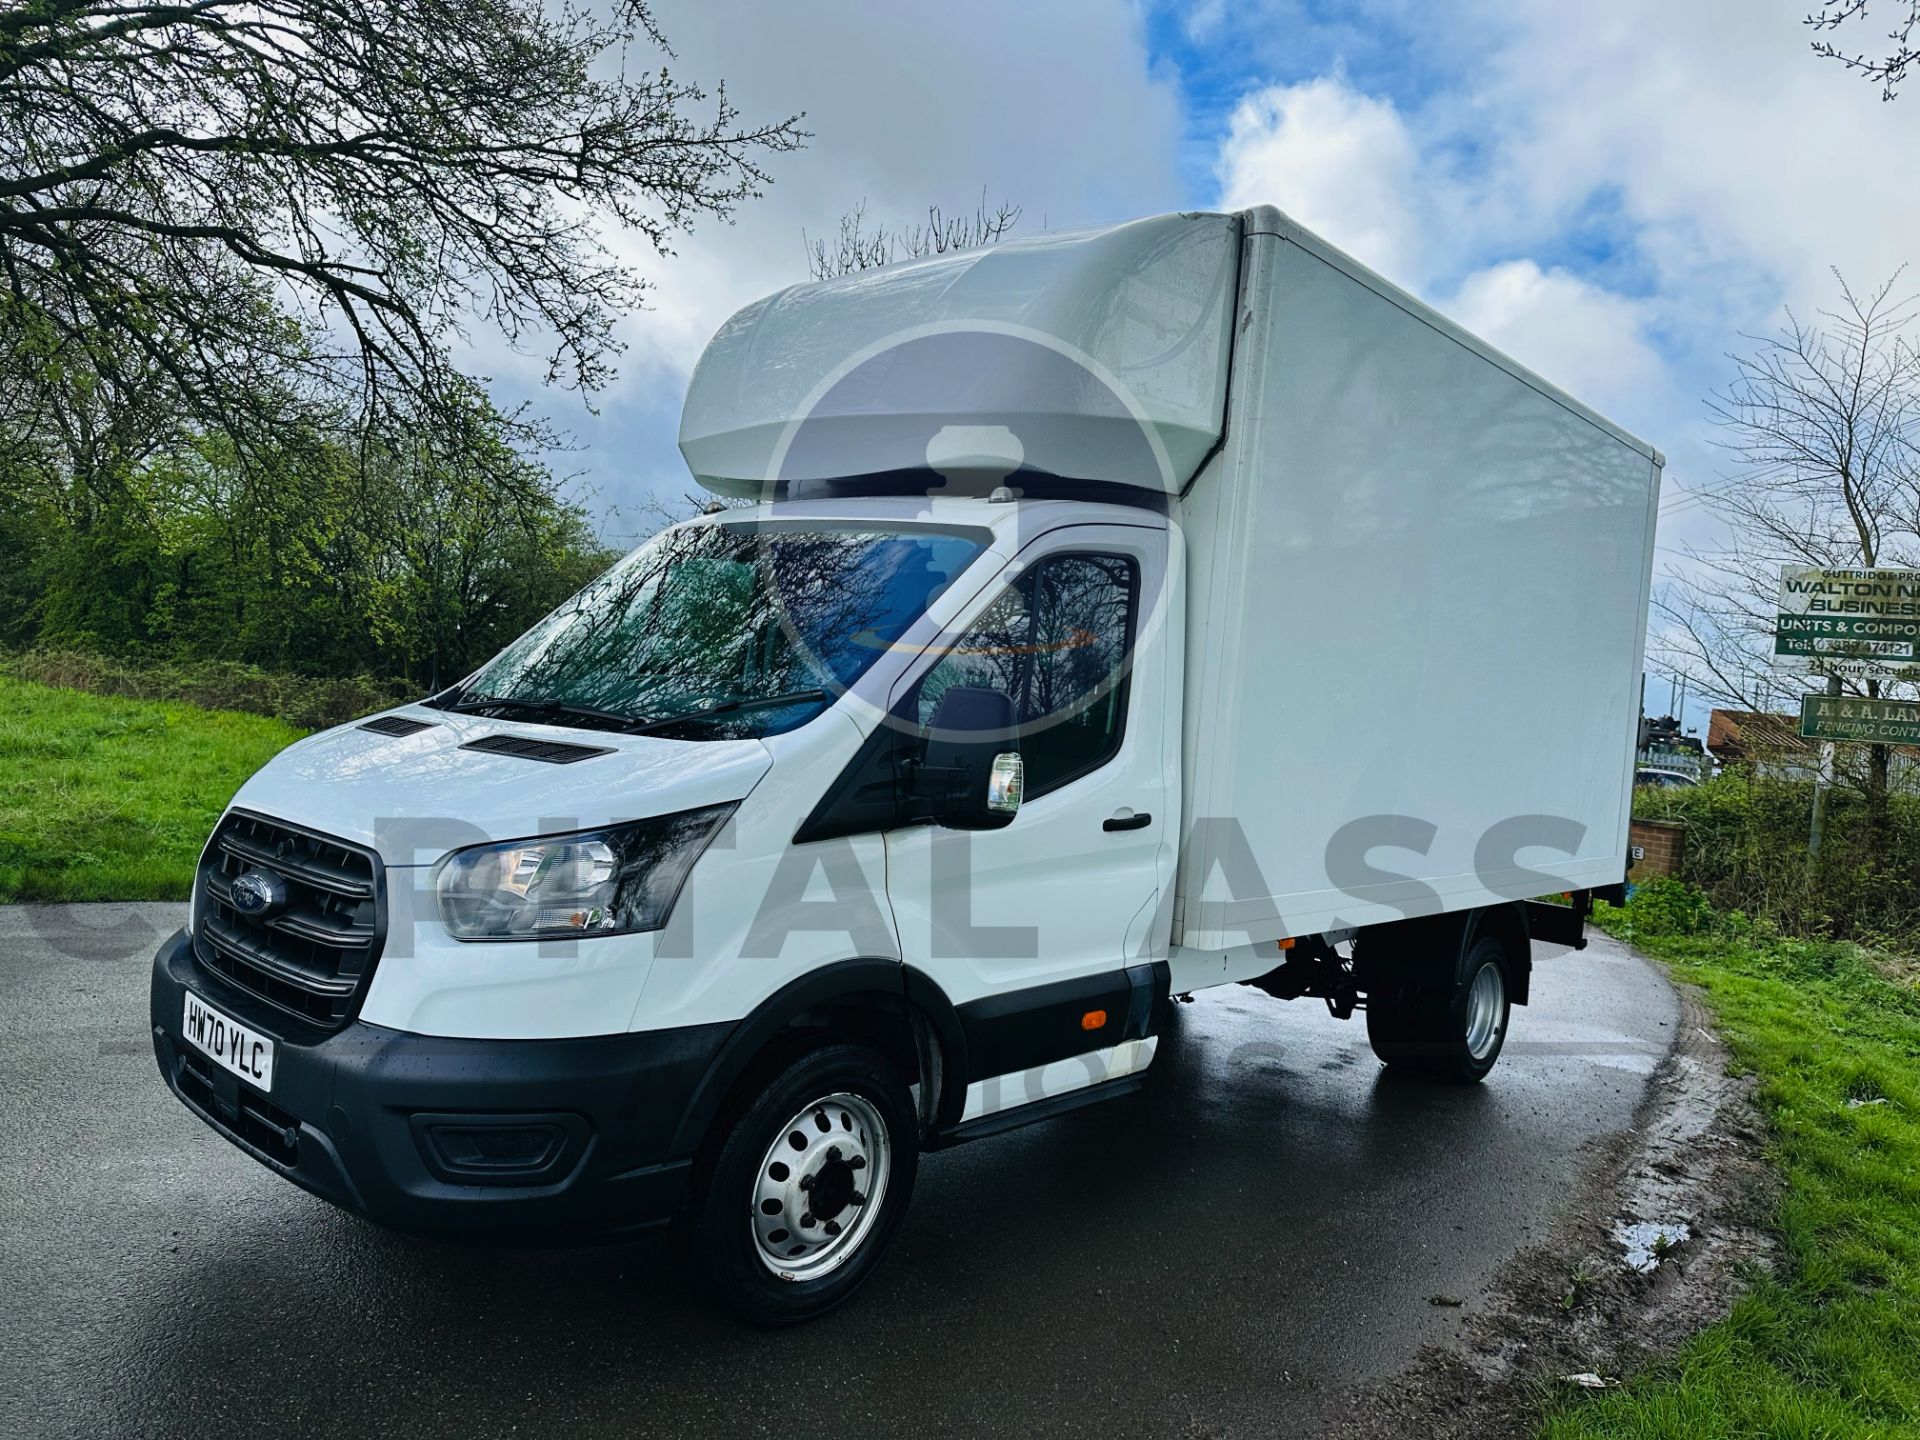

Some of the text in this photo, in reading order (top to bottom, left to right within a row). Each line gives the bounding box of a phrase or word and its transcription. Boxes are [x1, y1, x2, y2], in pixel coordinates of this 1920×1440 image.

[1822, 570, 1894, 581] GUTTRIDGE
[1786, 581, 1920, 598] WALTON N
[1810, 599, 1920, 616] BUSINES
[1780, 619, 1920, 636] UNITS & COMPO
[1786, 638, 1811, 650] Tel:
[1830, 662, 1863, 674] hour
[1841, 704, 1853, 718] &
[1816, 720, 1875, 734] FENCING
[188, 1001, 264, 1080] HW70 YLC
